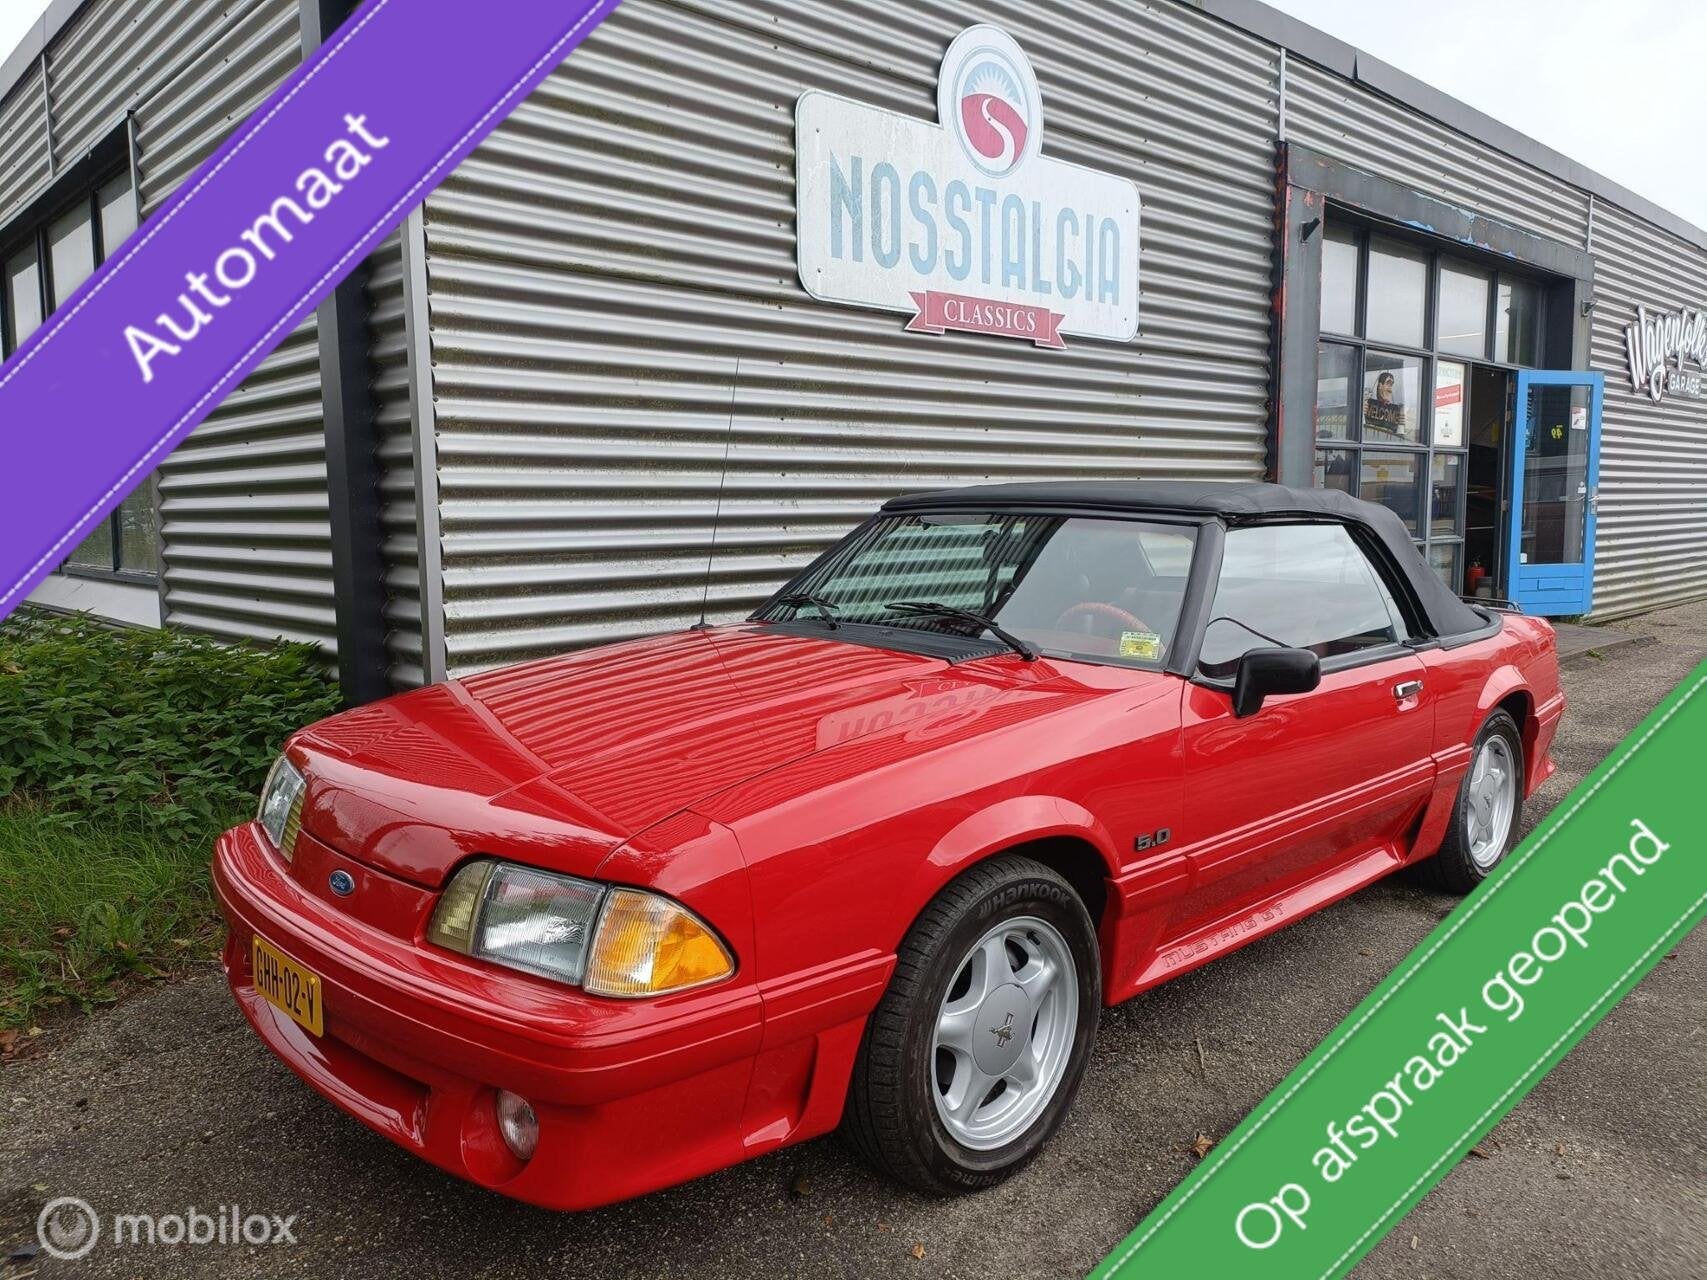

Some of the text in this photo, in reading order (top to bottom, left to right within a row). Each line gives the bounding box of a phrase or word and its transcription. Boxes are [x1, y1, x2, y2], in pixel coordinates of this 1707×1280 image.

[829, 150, 1120, 306] NOSSTALGIA
[943, 299, 1036, 332] CLASSICS
[1669, 373, 1700, 395] GARAGE
[1135, 828, 1171, 851] 5.0
[1161, 901, 1284, 968] MUSTANG GT
[256, 945, 316, 1025] GHH-02-V
